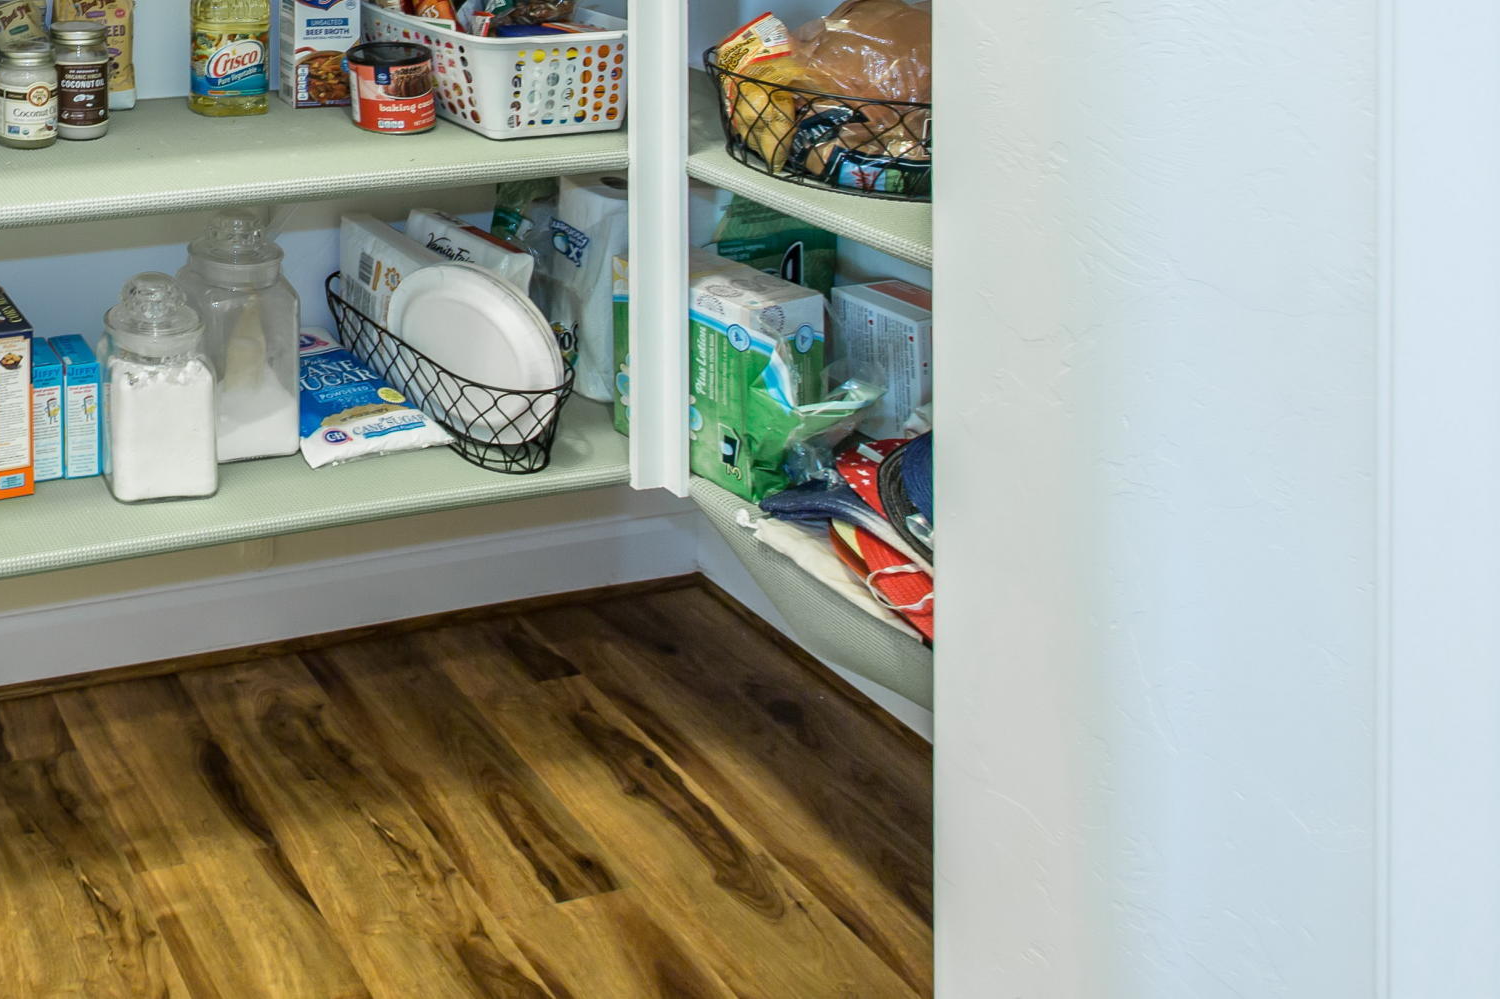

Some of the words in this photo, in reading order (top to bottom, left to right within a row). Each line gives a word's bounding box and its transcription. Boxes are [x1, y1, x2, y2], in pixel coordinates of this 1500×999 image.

[310, 18, 344, 26] UNSALTED
[324, 28, 350, 36] BROTH
[212, 50, 258, 78] Crisco
[60, 80, 95, 88] COCONUT
[378, 104, 416, 114] baking
[426, 232, 455, 261] Vanity
[696, 326, 708, 366] Lotion
[68, 367, 97, 376] JIFFY
[694, 366, 708, 396] Plus
[320, 386, 369, 400] POWDERED
[352, 420, 386, 436] CANE
[386, 414, 426, 428] SUGAR
